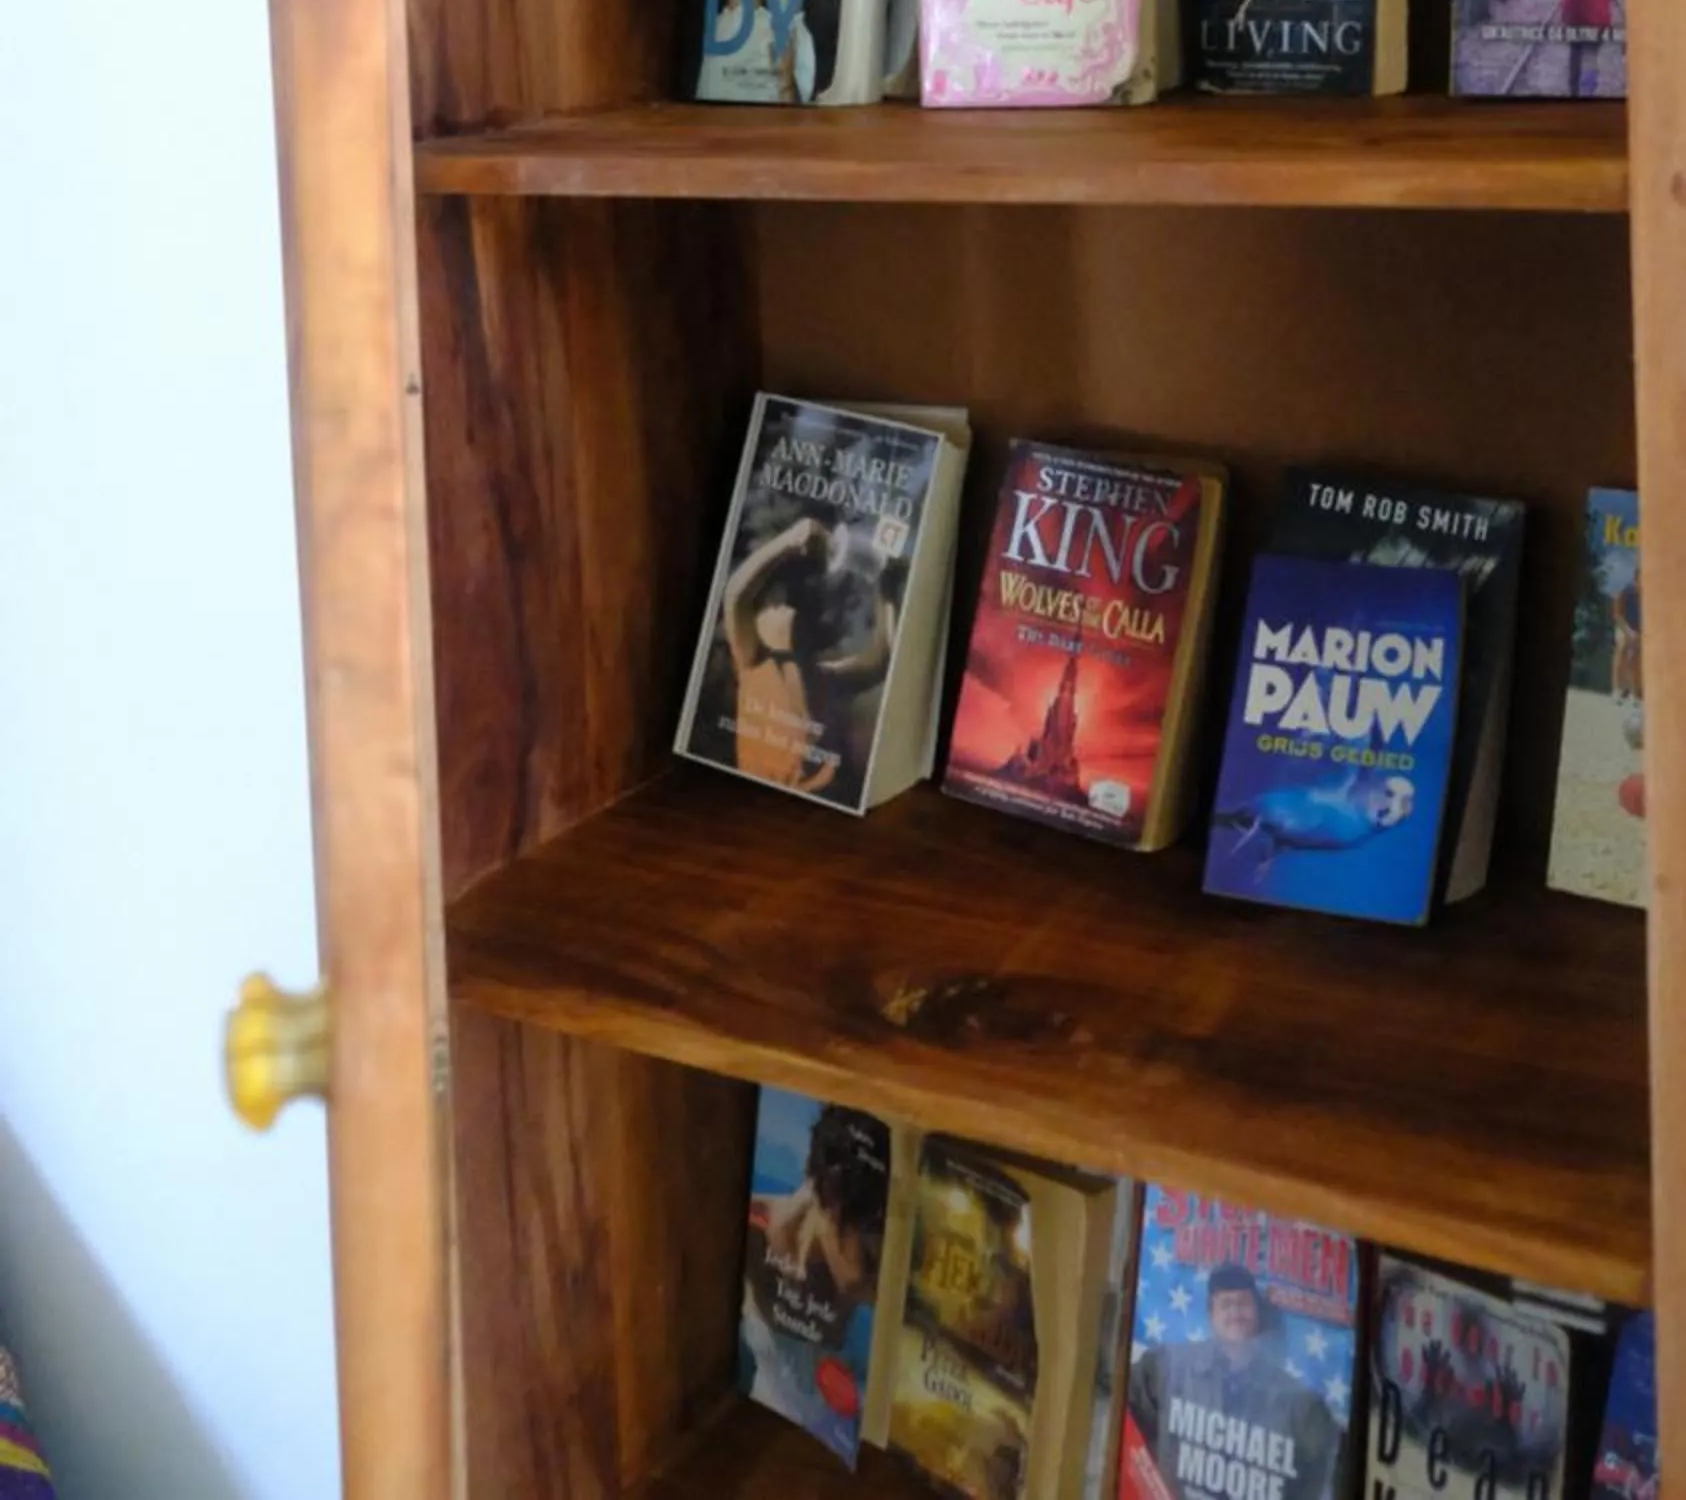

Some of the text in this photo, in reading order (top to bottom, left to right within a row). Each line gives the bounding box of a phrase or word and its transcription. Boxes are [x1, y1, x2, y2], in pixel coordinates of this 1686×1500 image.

[1201, 19, 1362, 55] LIVING
[1037, 466, 1173, 516] STEPHEN
[1309, 483, 1490, 541] TOM ROB SMITH
[1002, 489, 1181, 595] KING
[1000, 570, 1084, 626] WOLVES
[1103, 598, 1165, 645] CALLA
[1254, 618, 1445, 681] MARION
[1243, 662, 1443, 748] PAUW
[1256, 733, 1415, 772] GRIJS GEBIED
[1168, 1396, 1298, 1480] MICHAEL
[1177, 1443, 1286, 1500] MOORE
